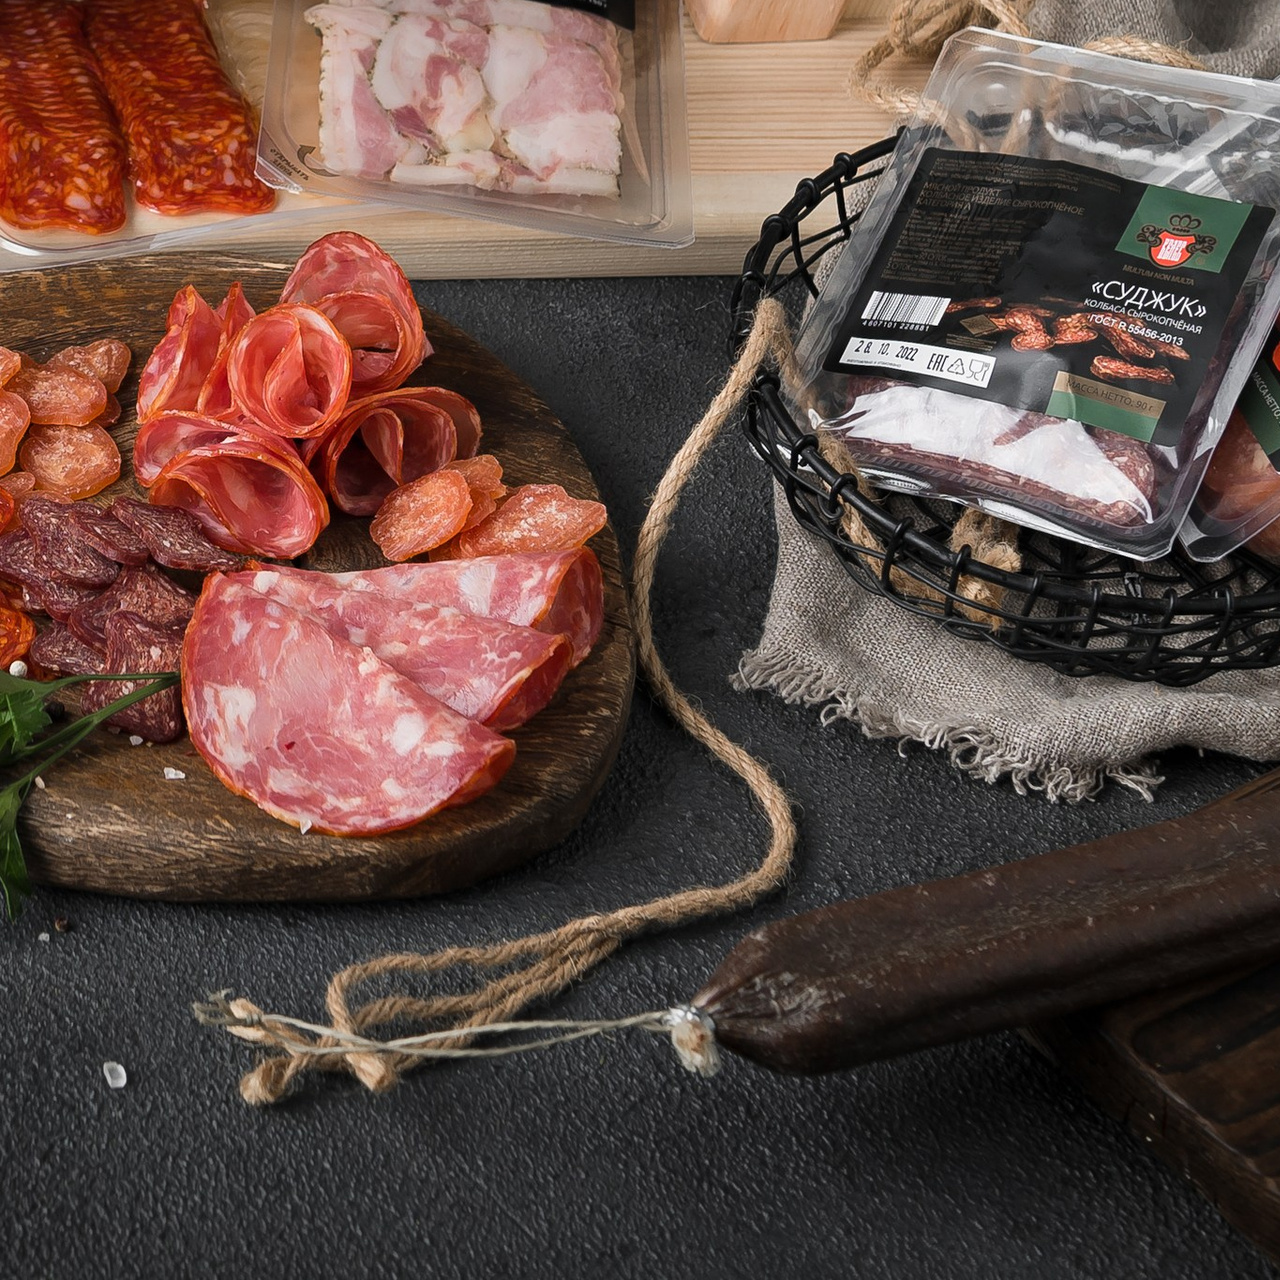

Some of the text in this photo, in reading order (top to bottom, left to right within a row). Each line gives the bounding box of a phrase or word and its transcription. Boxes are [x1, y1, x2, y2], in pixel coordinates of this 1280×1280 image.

[960, 184, 1002, 197] ПРОДУКТ
[970, 194, 1012, 207] ИЗДЕЛИЕ
[1091, 280, 1207, 318] «СУДЖУК»
[1083, 298, 1203, 335] КОЛБАСА СЫРОКОПЧЁНАЯ
[1089, 314, 1117, 327] ГОСТ
[1127, 324, 1184, 346] 55456-2013
[895, 345, 919, 362] 2022
[1066, 379, 1099, 395] МАССА
[1100, 389, 1133, 407] НЕТТО:
[1135, 400, 1148, 410] 90
[1252, 371, 1269, 396] МАССА
